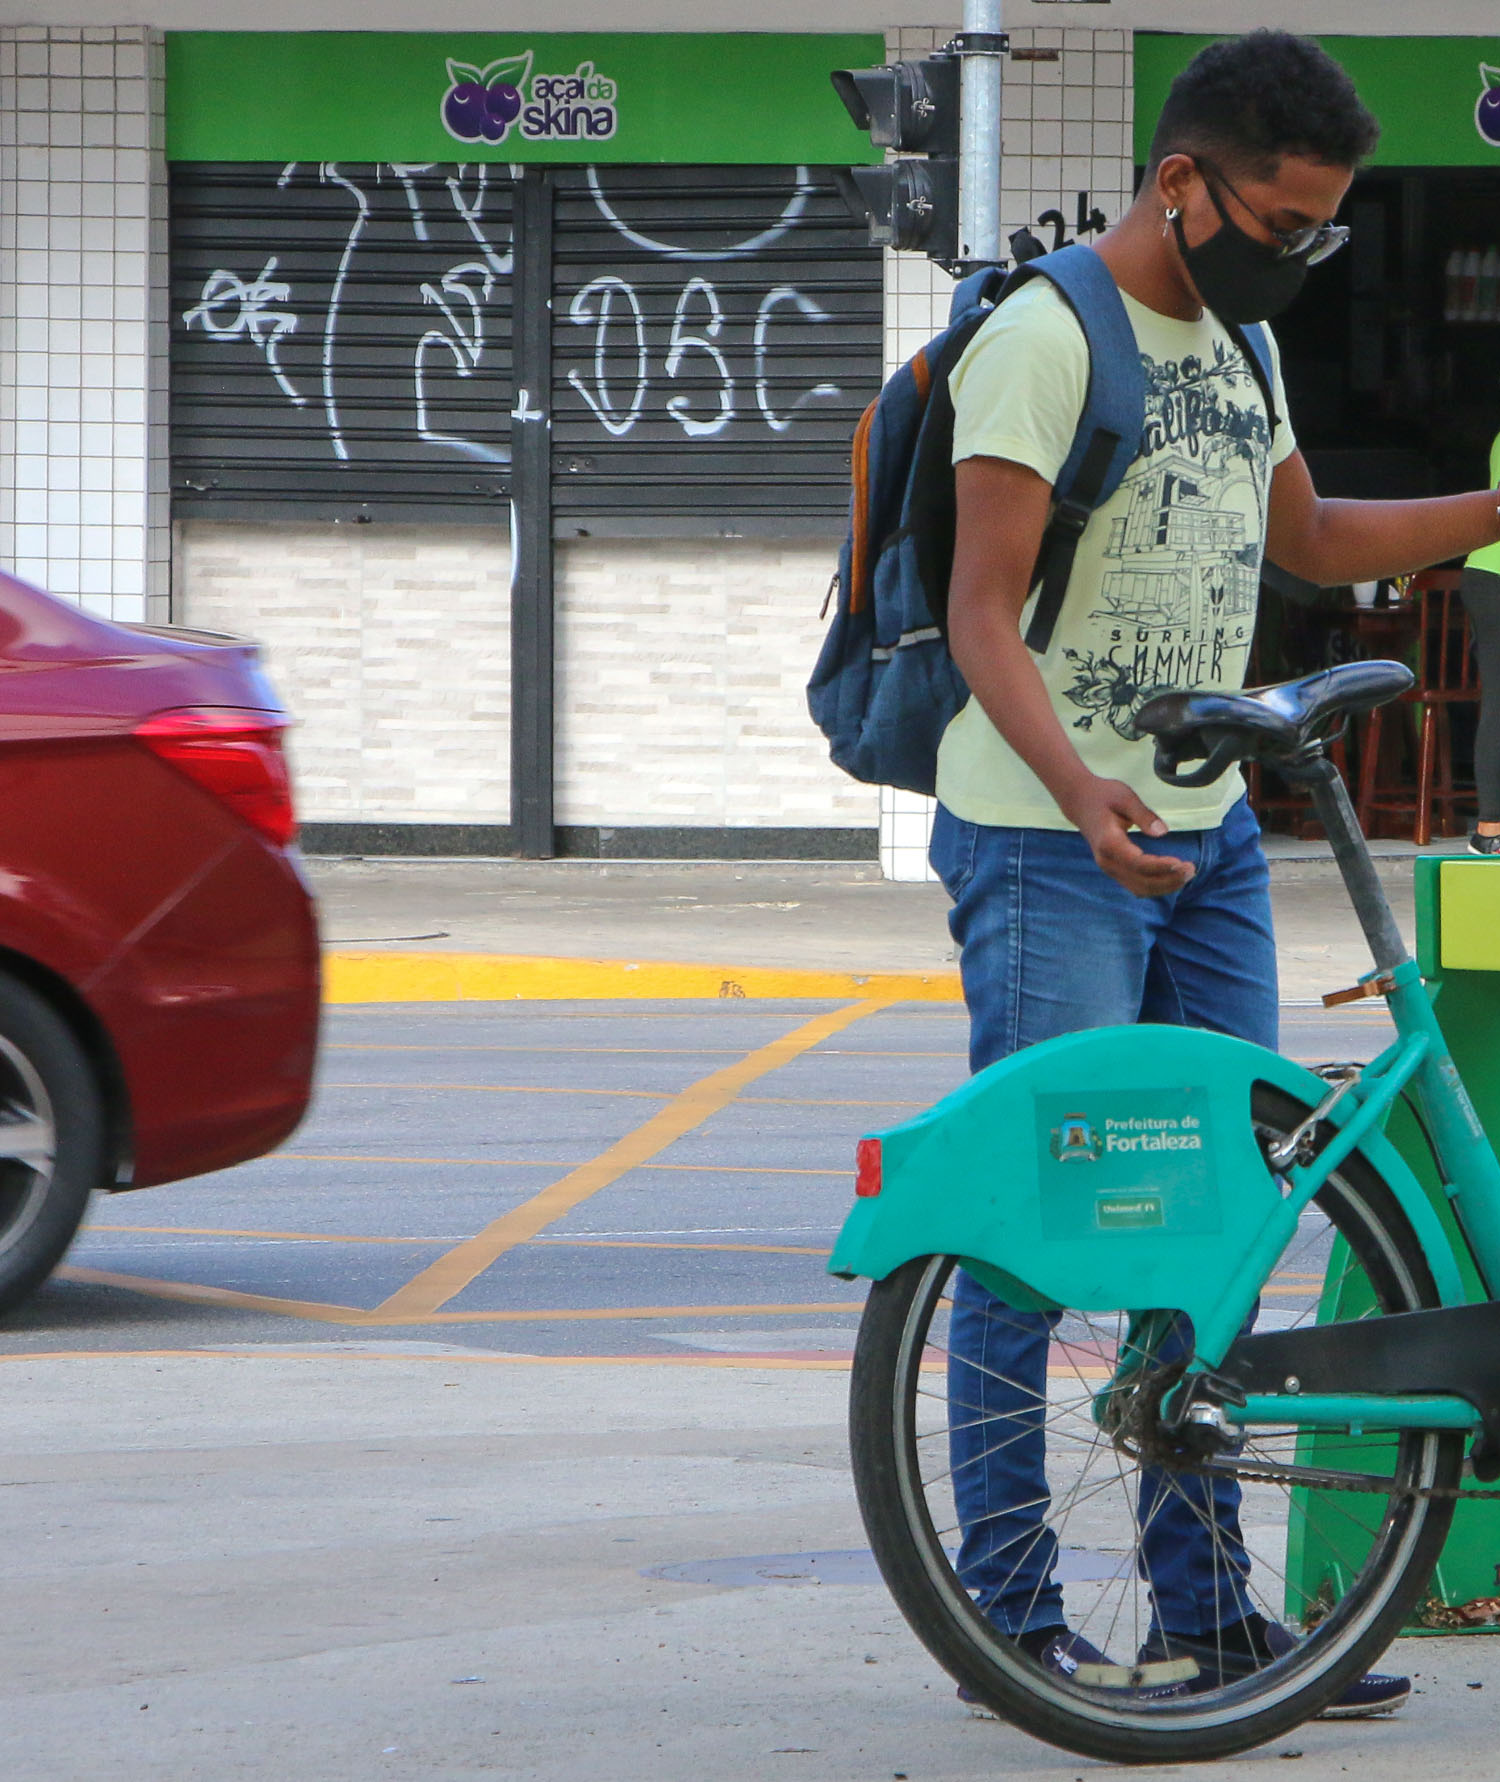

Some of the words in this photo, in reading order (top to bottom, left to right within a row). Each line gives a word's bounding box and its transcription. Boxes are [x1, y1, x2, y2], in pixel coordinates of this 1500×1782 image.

[587, 80, 613, 100] da
[523, 98, 613, 136] skina
[1110, 627, 1244, 643] SURFING
[1108, 643, 1223, 687] SUMMER
[1105, 1117, 1178, 1130] Prefeitura
[1181, 1115, 1200, 1129] de
[1106, 1132, 1202, 1152] Fortaleza
